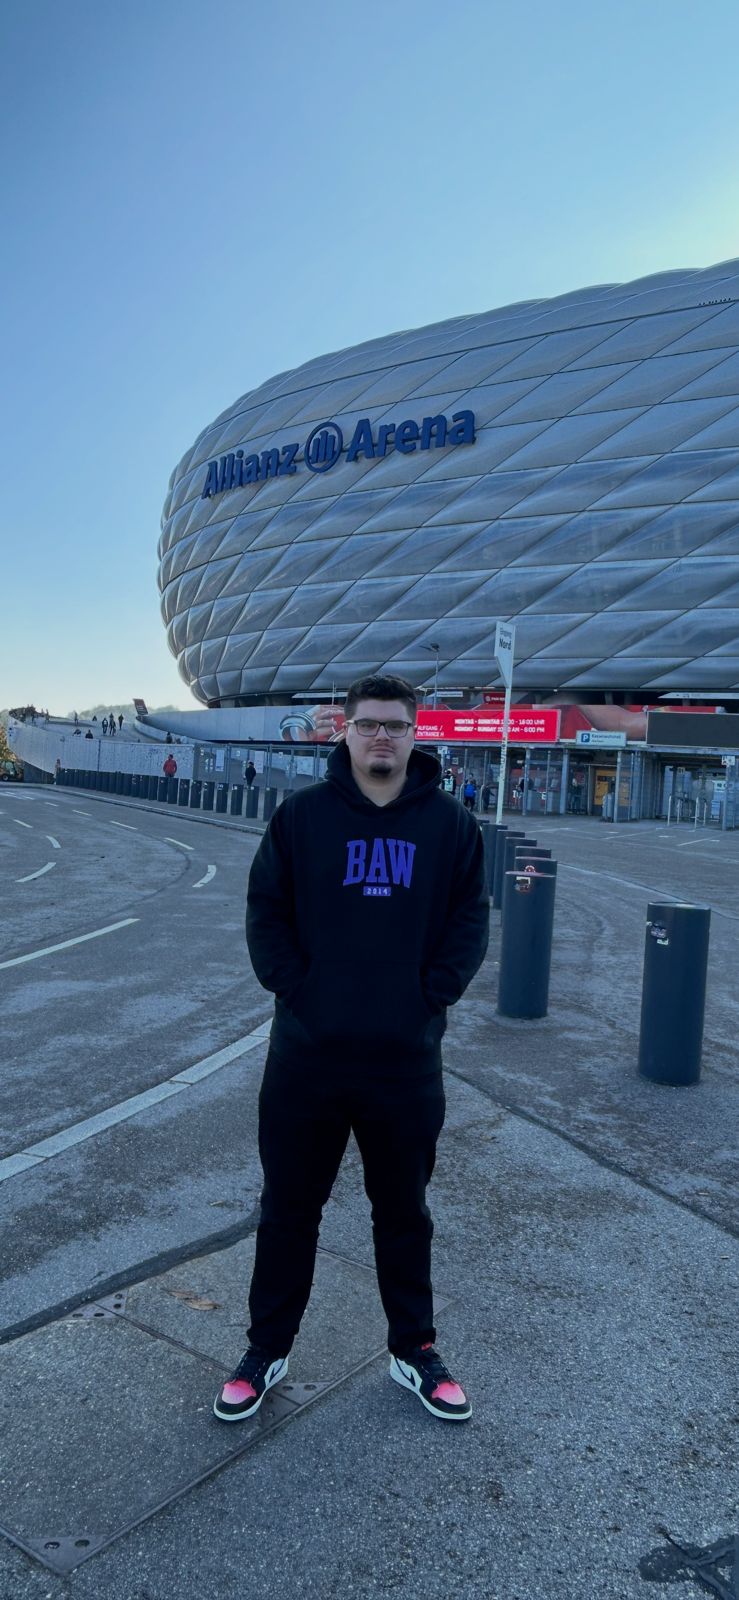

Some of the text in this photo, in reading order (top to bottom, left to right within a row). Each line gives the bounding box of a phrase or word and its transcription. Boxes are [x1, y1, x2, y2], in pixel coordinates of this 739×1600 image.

[201, 409, 476, 499] Allianz Arena
[499, 638, 512, 650] Nord
[342, 838, 416, 888] BAW
